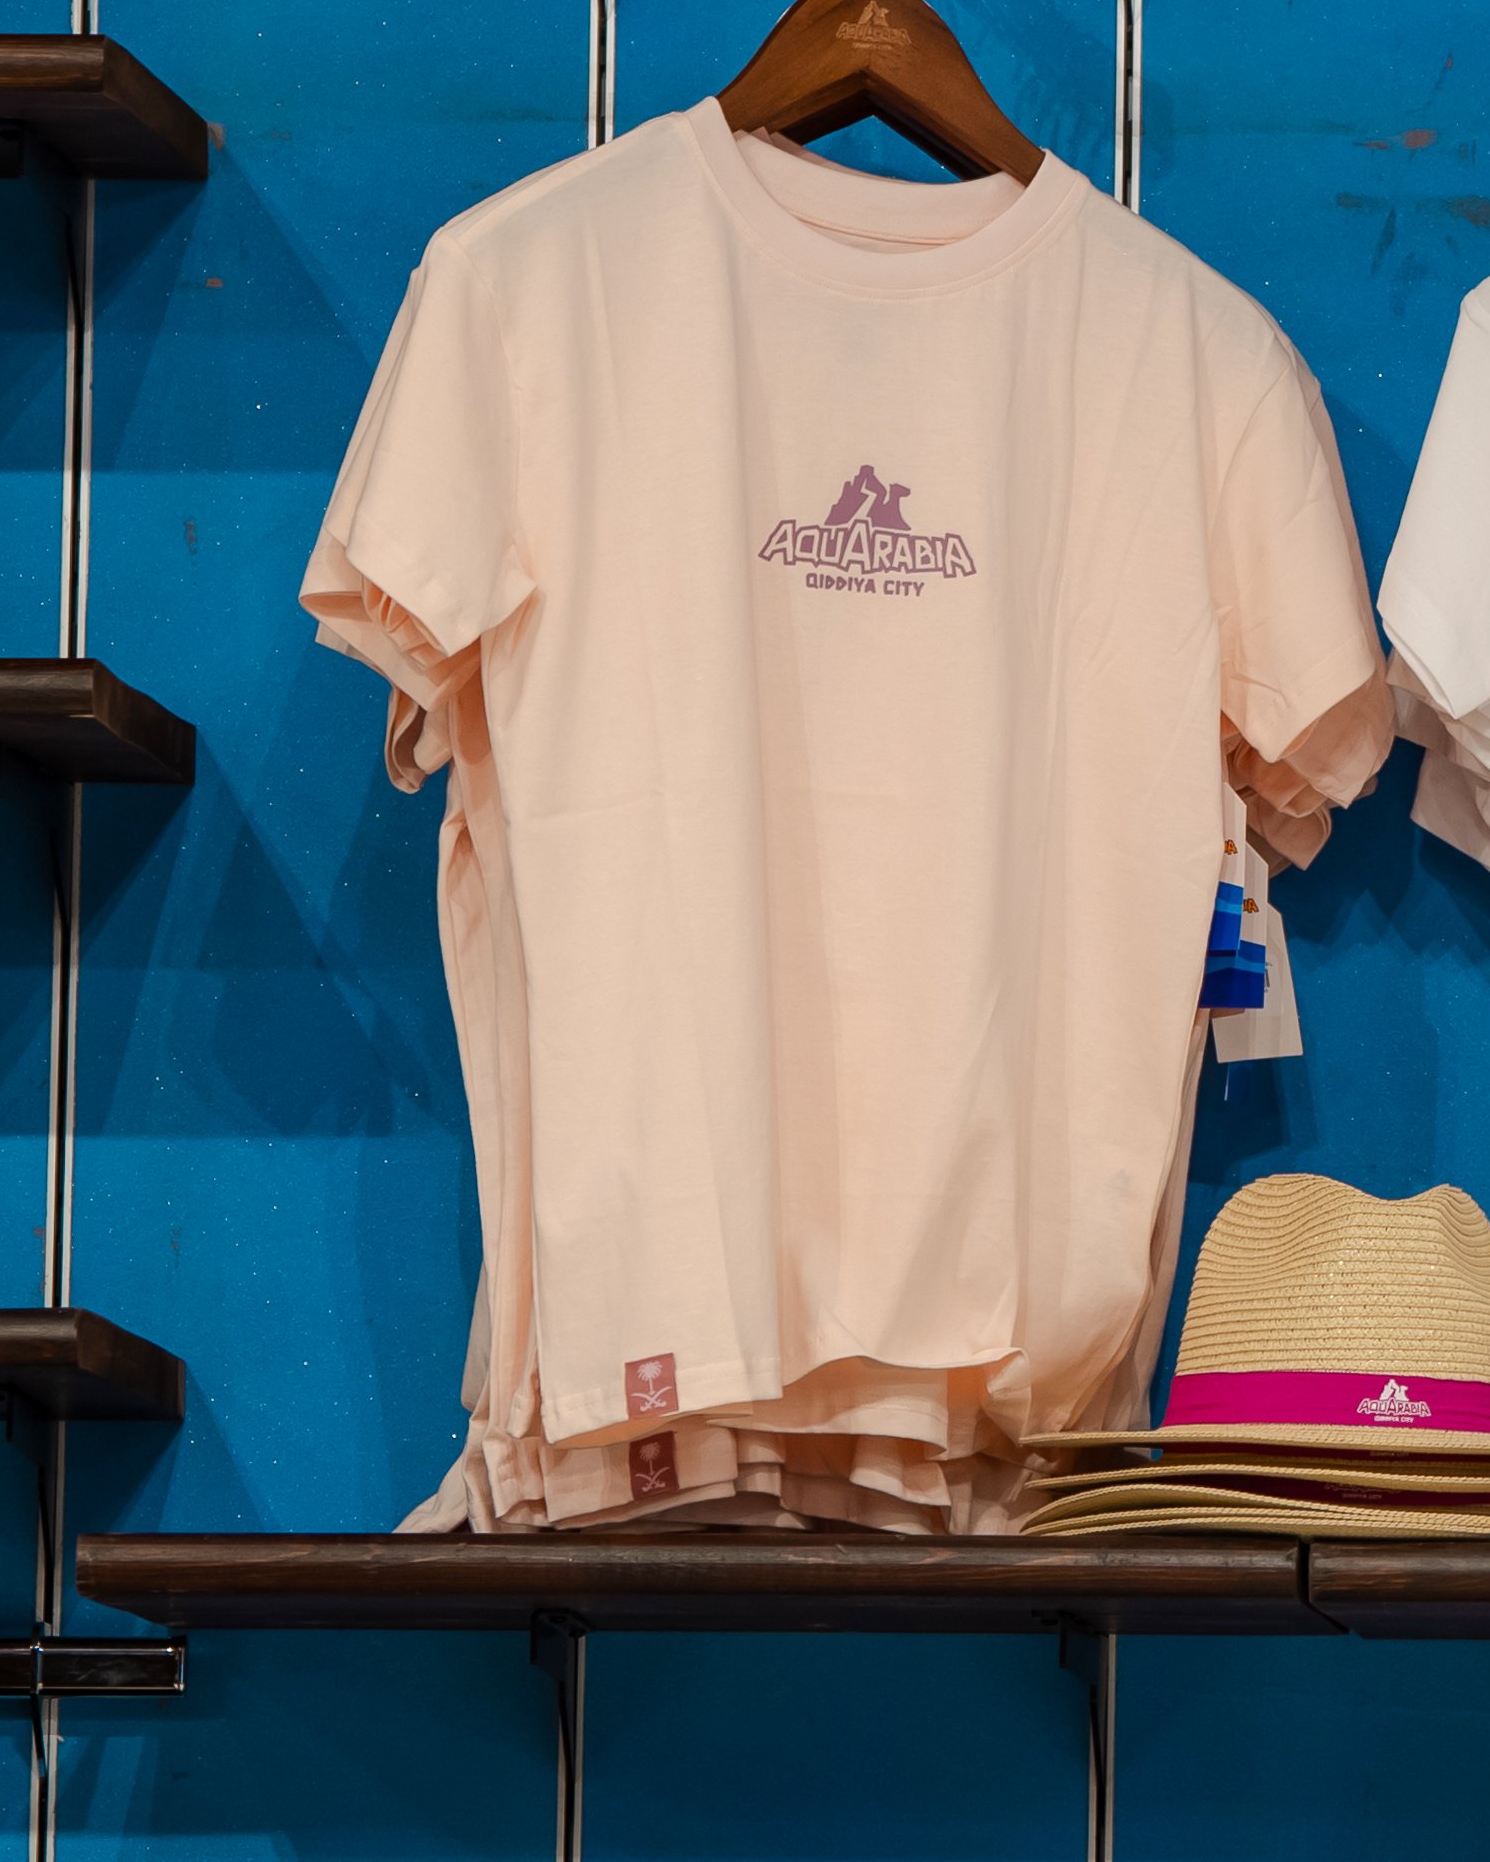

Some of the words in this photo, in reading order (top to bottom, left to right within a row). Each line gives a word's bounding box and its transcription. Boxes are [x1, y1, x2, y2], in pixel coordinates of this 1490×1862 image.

[758, 519, 977, 578] AQUARABIA
[806, 573, 876, 594] QIDDIYA
[883, 580, 924, 596] CITY
[1357, 1397, 1431, 1417] AQUARABIA
